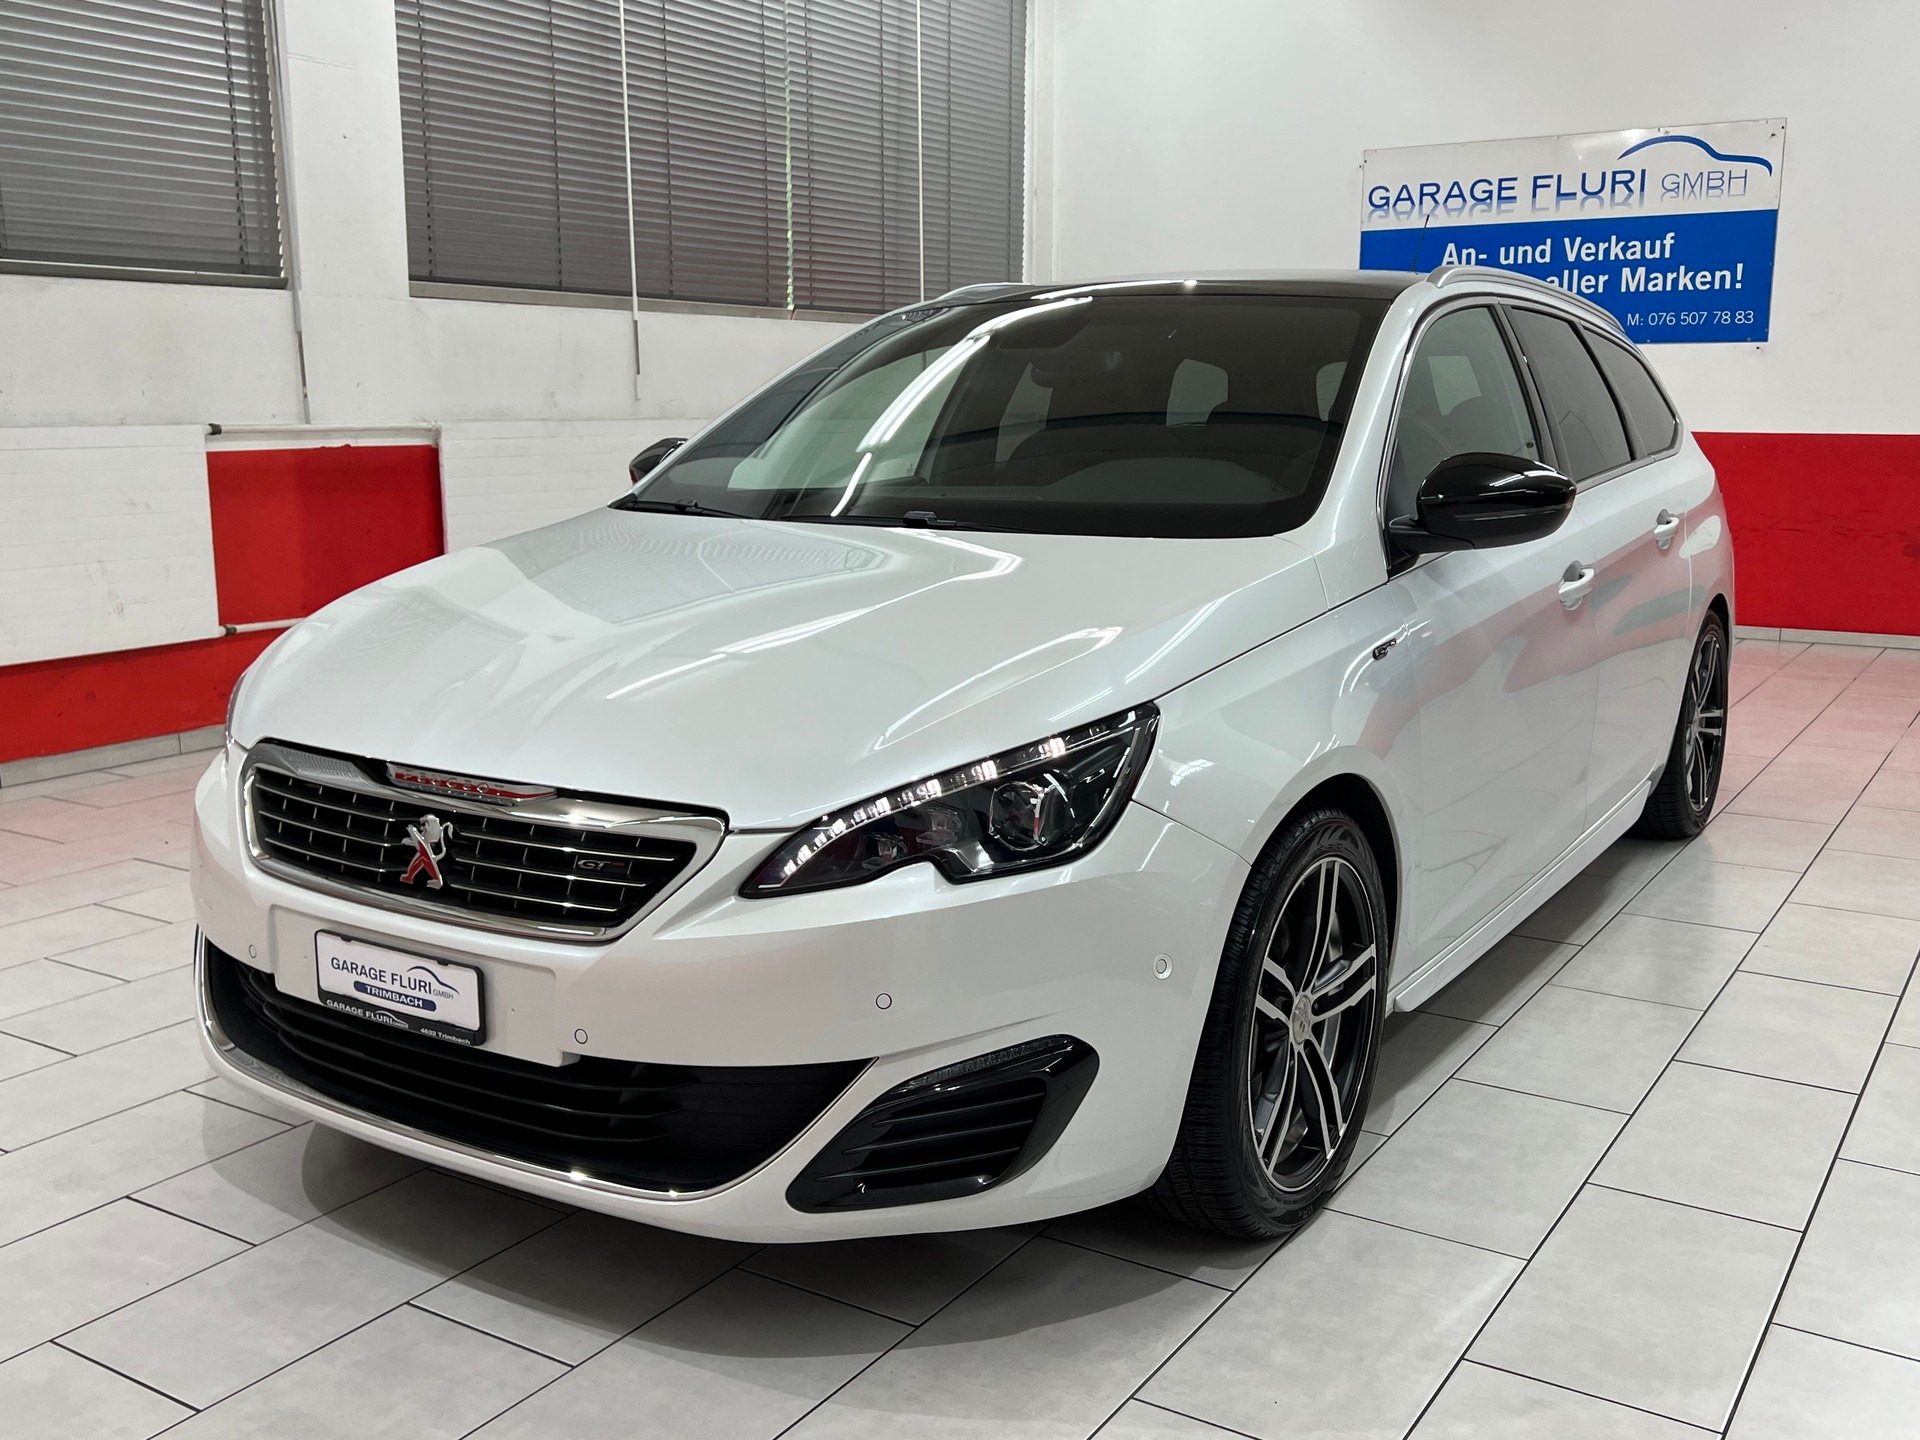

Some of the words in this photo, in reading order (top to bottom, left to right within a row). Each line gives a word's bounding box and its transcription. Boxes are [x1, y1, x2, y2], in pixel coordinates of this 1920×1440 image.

[1368, 176, 1518, 209] GARAGE
[1532, 168, 1646, 199] FLURI
[1661, 168, 1748, 193] GMBH
[1441, 243, 1487, 266] An-
[1499, 238, 1552, 265] und
[1564, 232, 1675, 262] Verkauf
[1621, 263, 1743, 292] Marken!
[1627, 313, 1644, 326] M:
[1648, 312, 1676, 326] 076
[1680, 311, 1708, 325] 507
[1712, 311, 1732, 324] 78
[1734, 310, 1755, 324] 83
[331, 957, 387, 983] GARAGE
[391, 973, 433, 995] FLURI
[432, 988, 454, 1000] GMBH
[364, 985, 423, 1008] TRIMBACH
[326, 999, 363, 1016] GARAGE
[366, 1011, 393, 1025] FLURI
[438, 1031, 471, 1045] Trimbach
